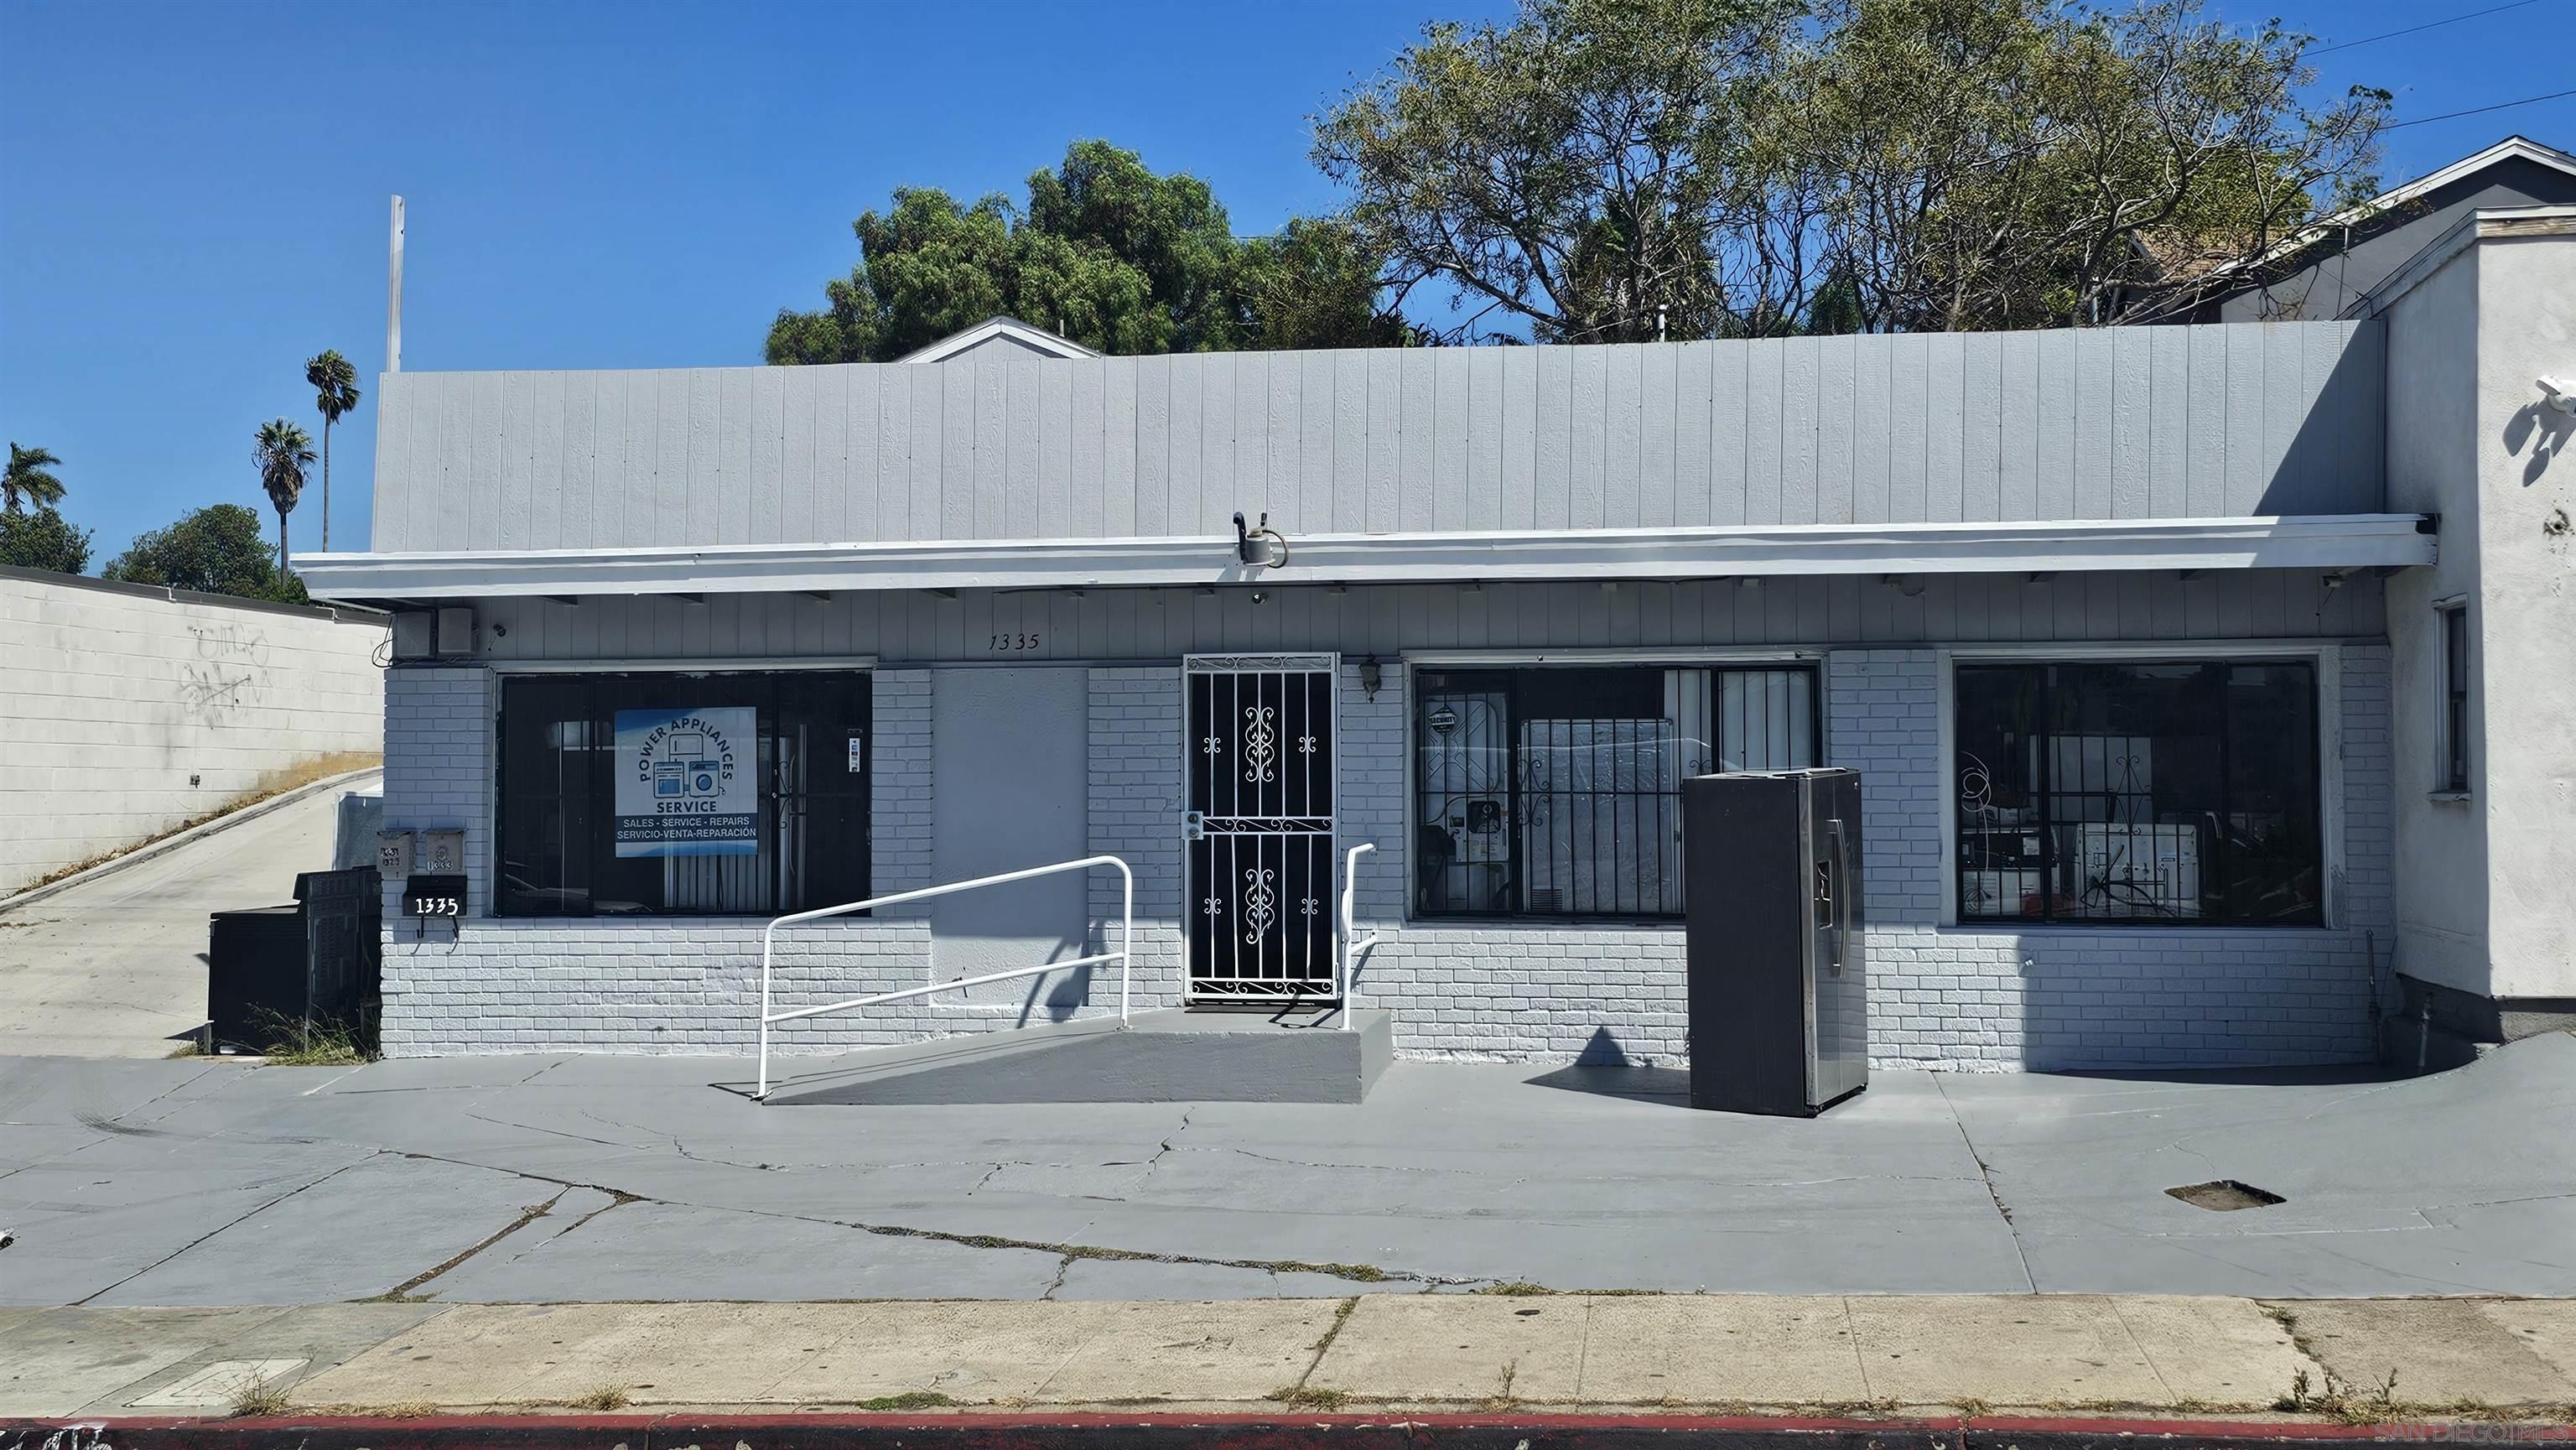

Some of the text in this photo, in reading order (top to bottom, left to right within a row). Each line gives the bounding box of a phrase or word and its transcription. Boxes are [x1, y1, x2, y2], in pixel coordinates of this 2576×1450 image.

[989, 632, 1039, 650] 1335
[638, 717, 734, 782] POWER APPLIANCES
[657, 801, 717, 813] SERVICE
[623, 819, 654, 828] SALES
[662, 818, 702, 827] SERVICE
[709, 817, 750, 826] REPAIRS
[415, 897, 459, 916] 1335
